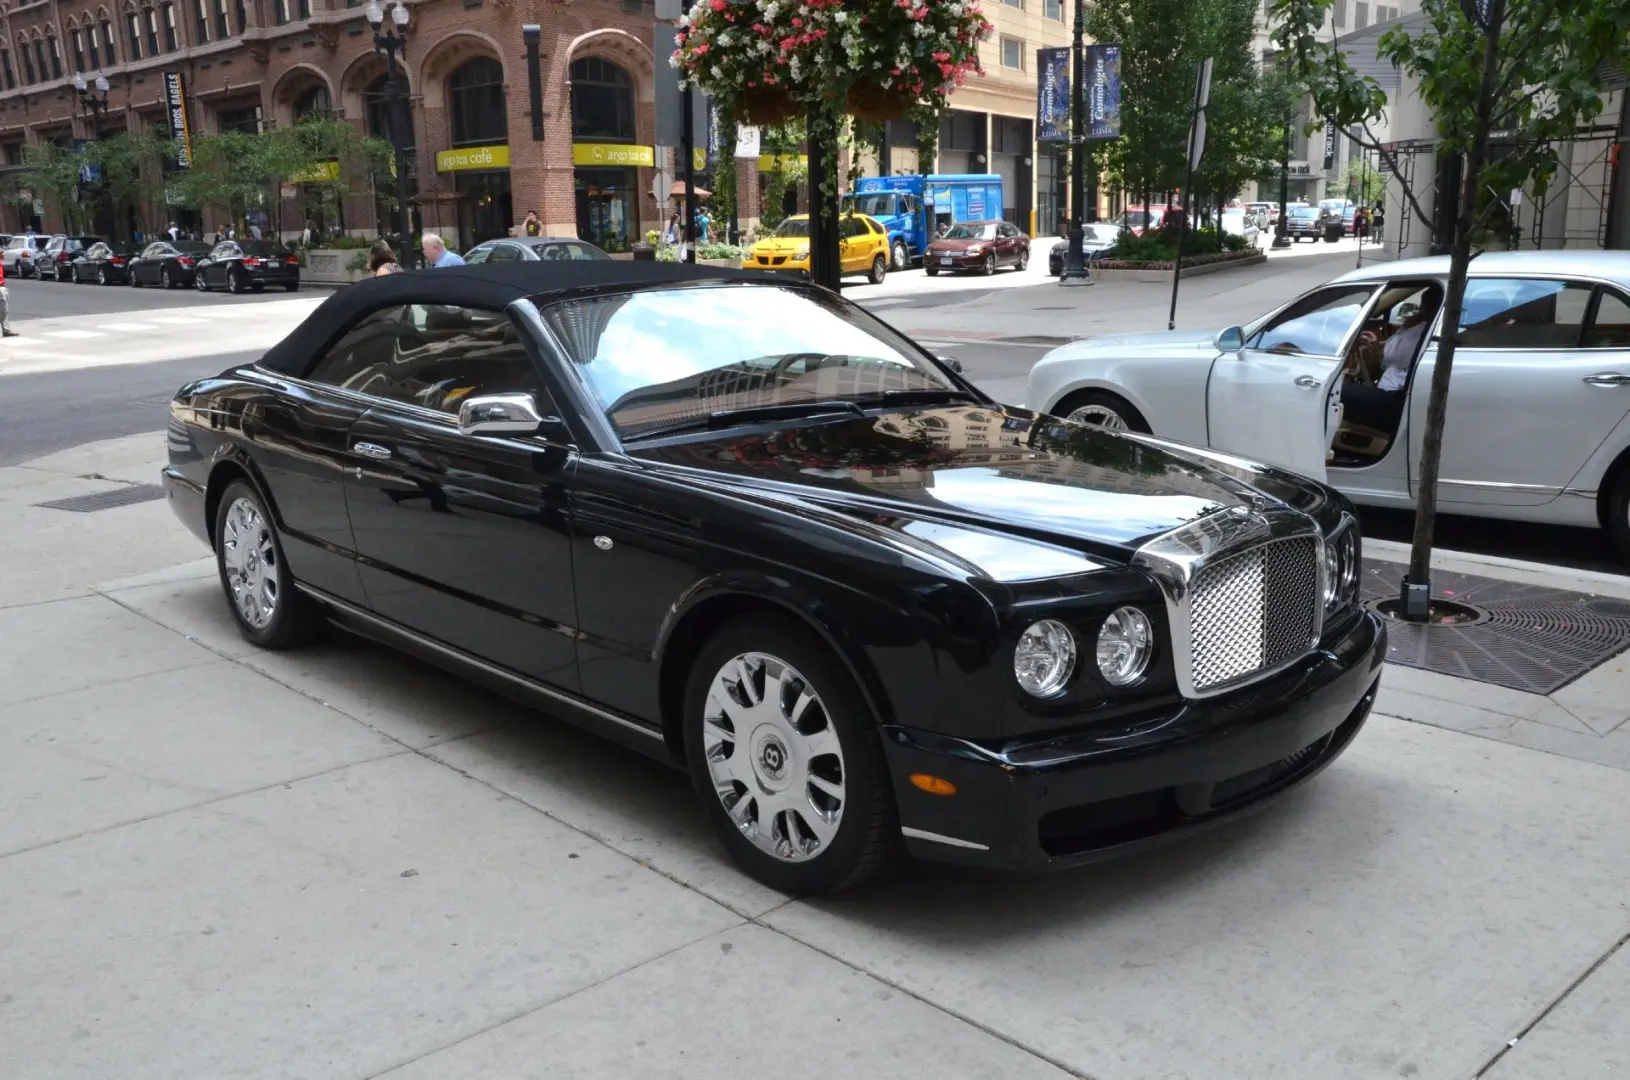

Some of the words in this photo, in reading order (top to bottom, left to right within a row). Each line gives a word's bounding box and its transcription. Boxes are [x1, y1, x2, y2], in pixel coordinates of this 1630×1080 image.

[168, 74, 182, 105] BAGELS
[1045, 63, 1055, 122] Cosmologies
[1095, 59, 1105, 120] Cosmologies
[469, 147, 493, 164] café
[607, 150, 627, 164] argo
[628, 148, 639, 160] tea
[1325, 136, 1334, 157] rack
